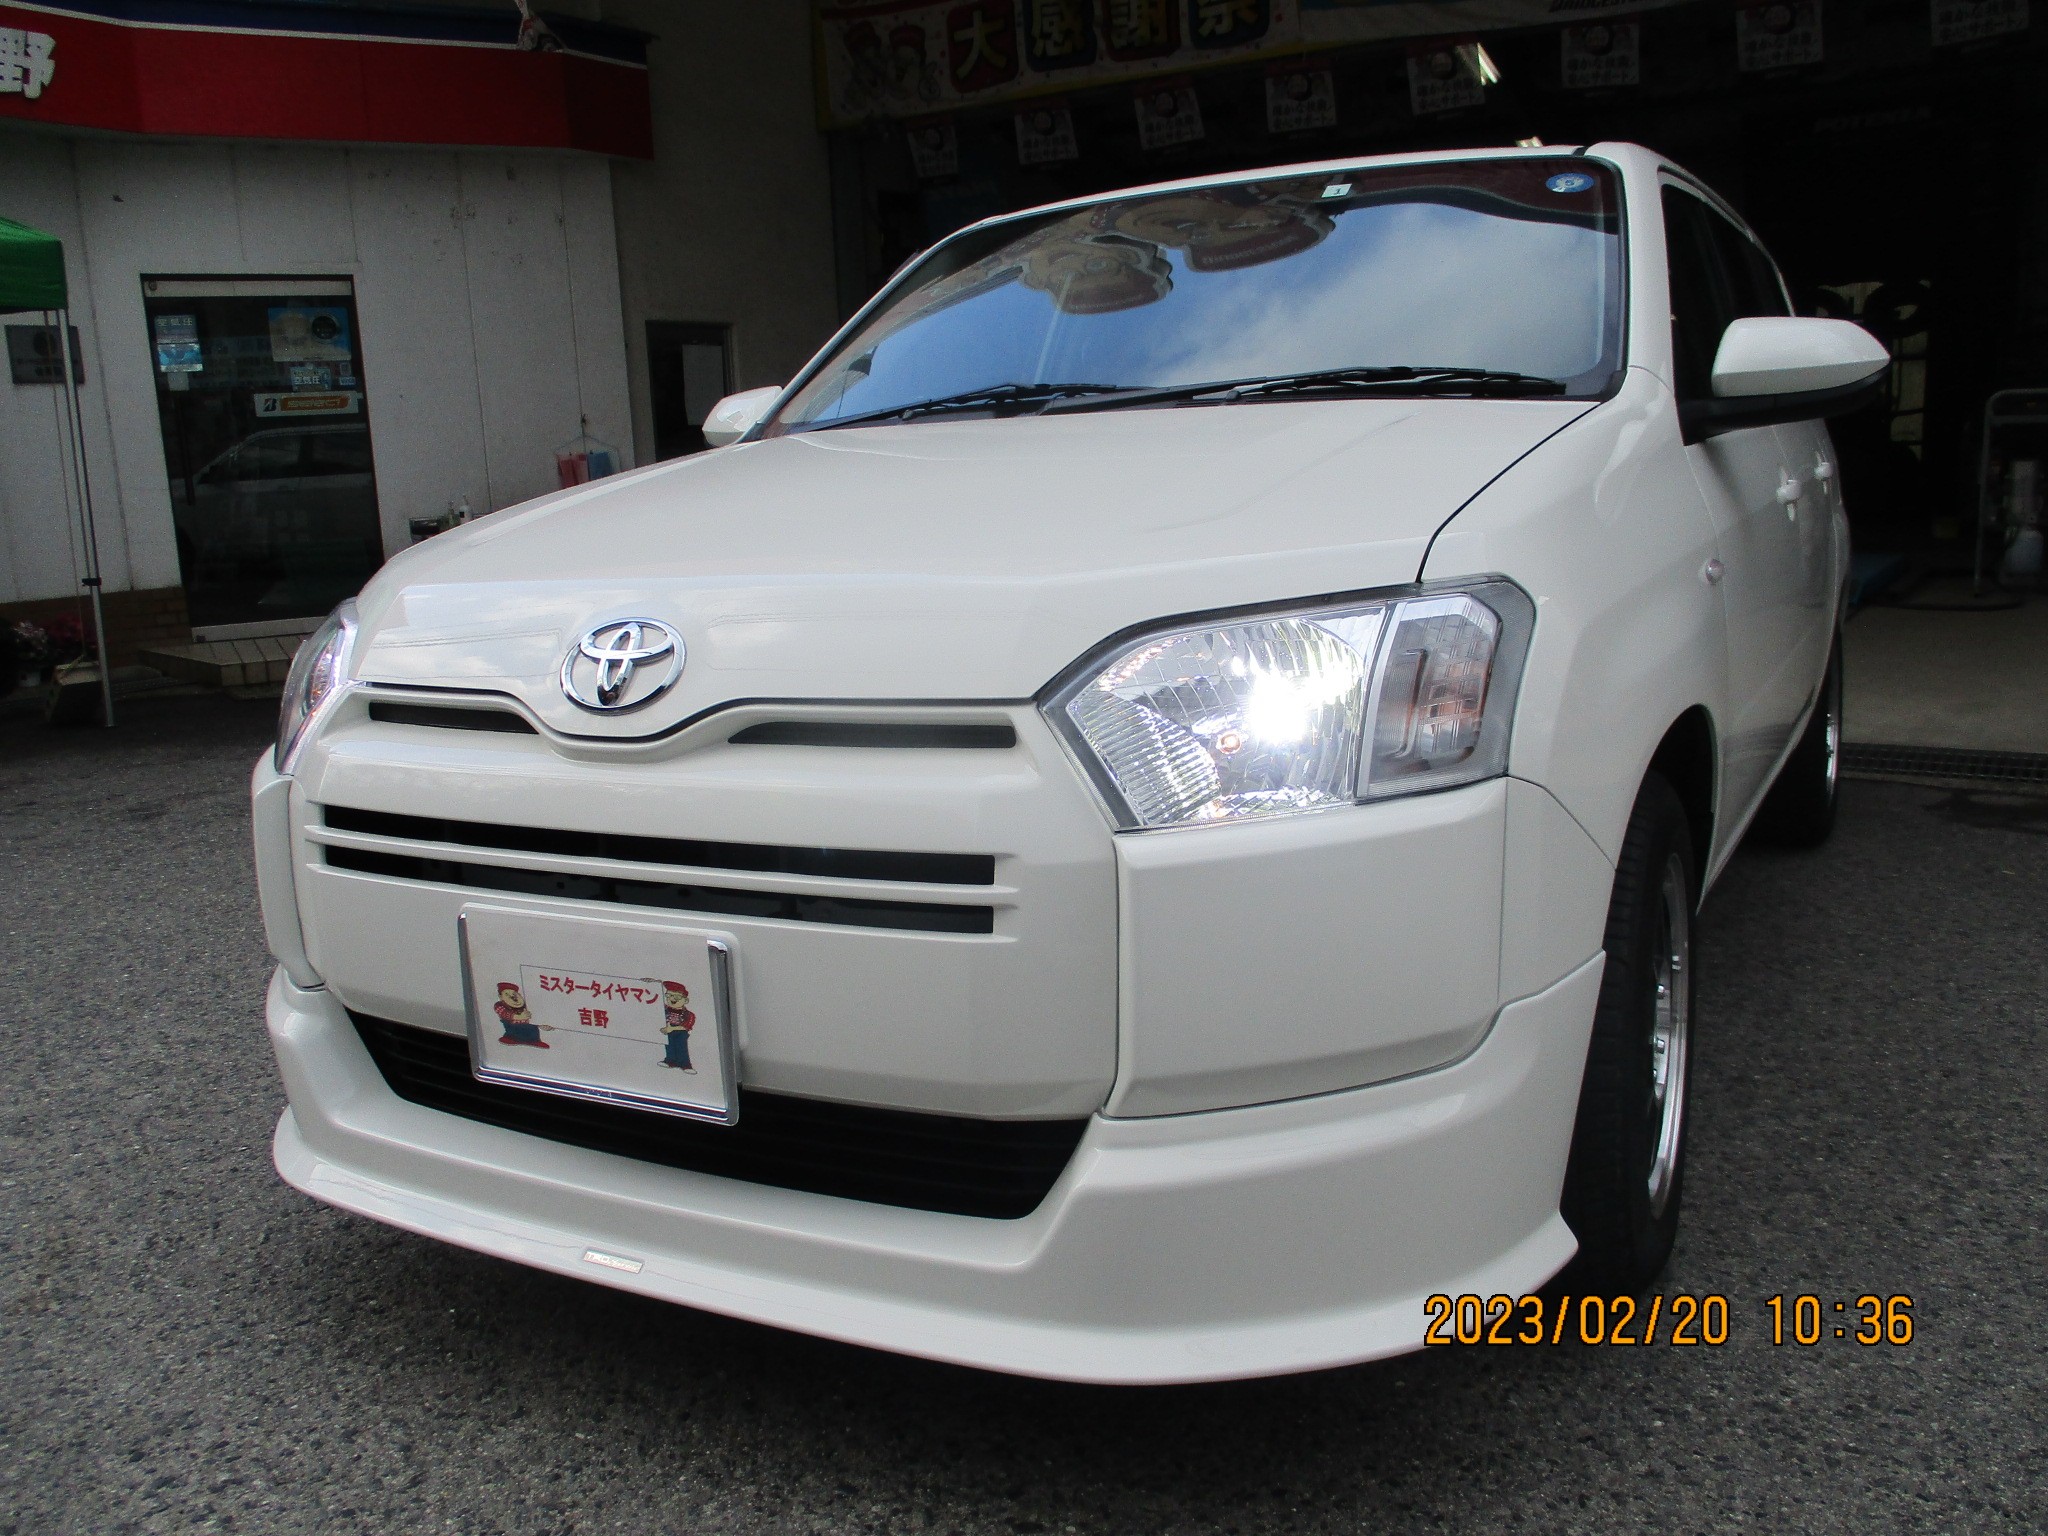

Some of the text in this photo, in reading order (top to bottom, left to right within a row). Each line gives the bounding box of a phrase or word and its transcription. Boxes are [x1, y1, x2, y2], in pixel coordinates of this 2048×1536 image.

[0, 27, 56, 100] 野
[539, 974, 659, 1005] ミスタータイヤマン
[578, 1007, 610, 1029] 吉野
